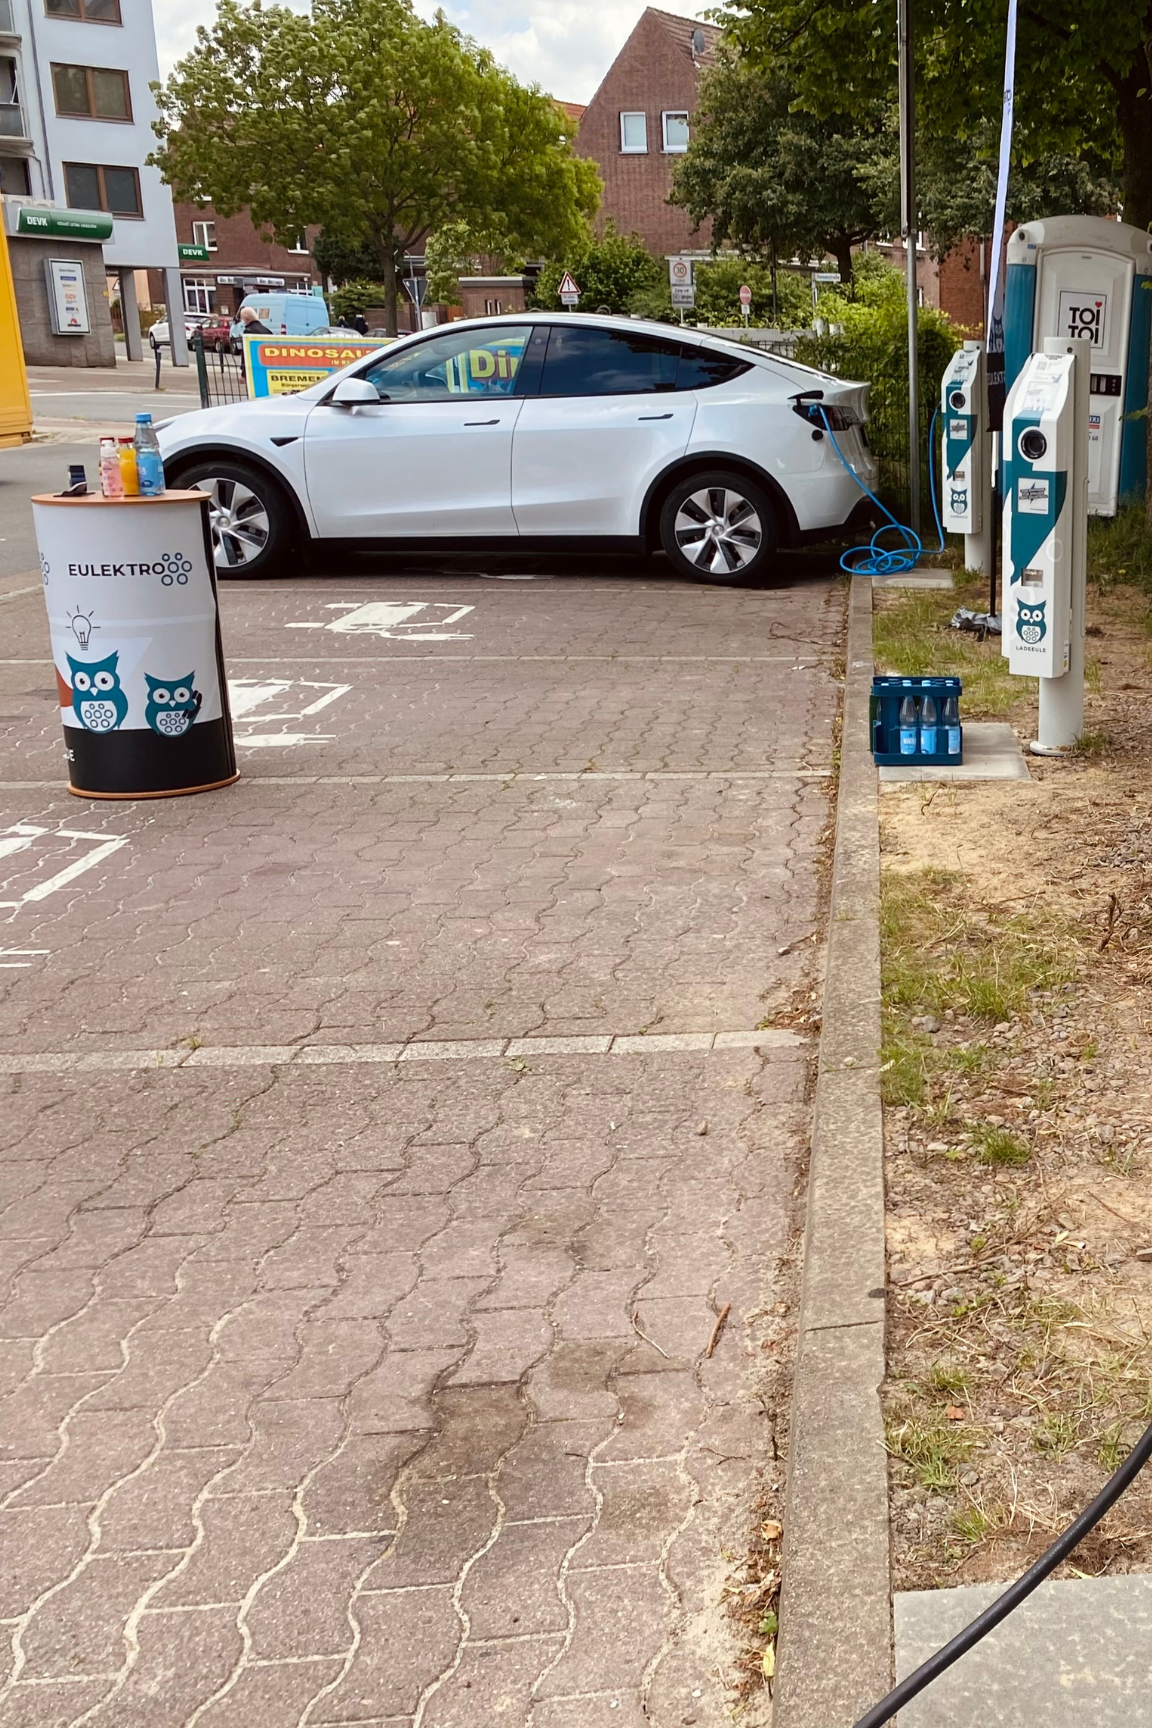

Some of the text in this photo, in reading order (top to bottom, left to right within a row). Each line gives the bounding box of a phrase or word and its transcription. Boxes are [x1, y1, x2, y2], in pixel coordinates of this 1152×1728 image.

[26, 216, 48, 227] DEVK
[182, 248, 203, 256] DEVK
[68, 562, 165, 577] EULEKTRO
[1016, 645, 1047, 653] LADEEULE
